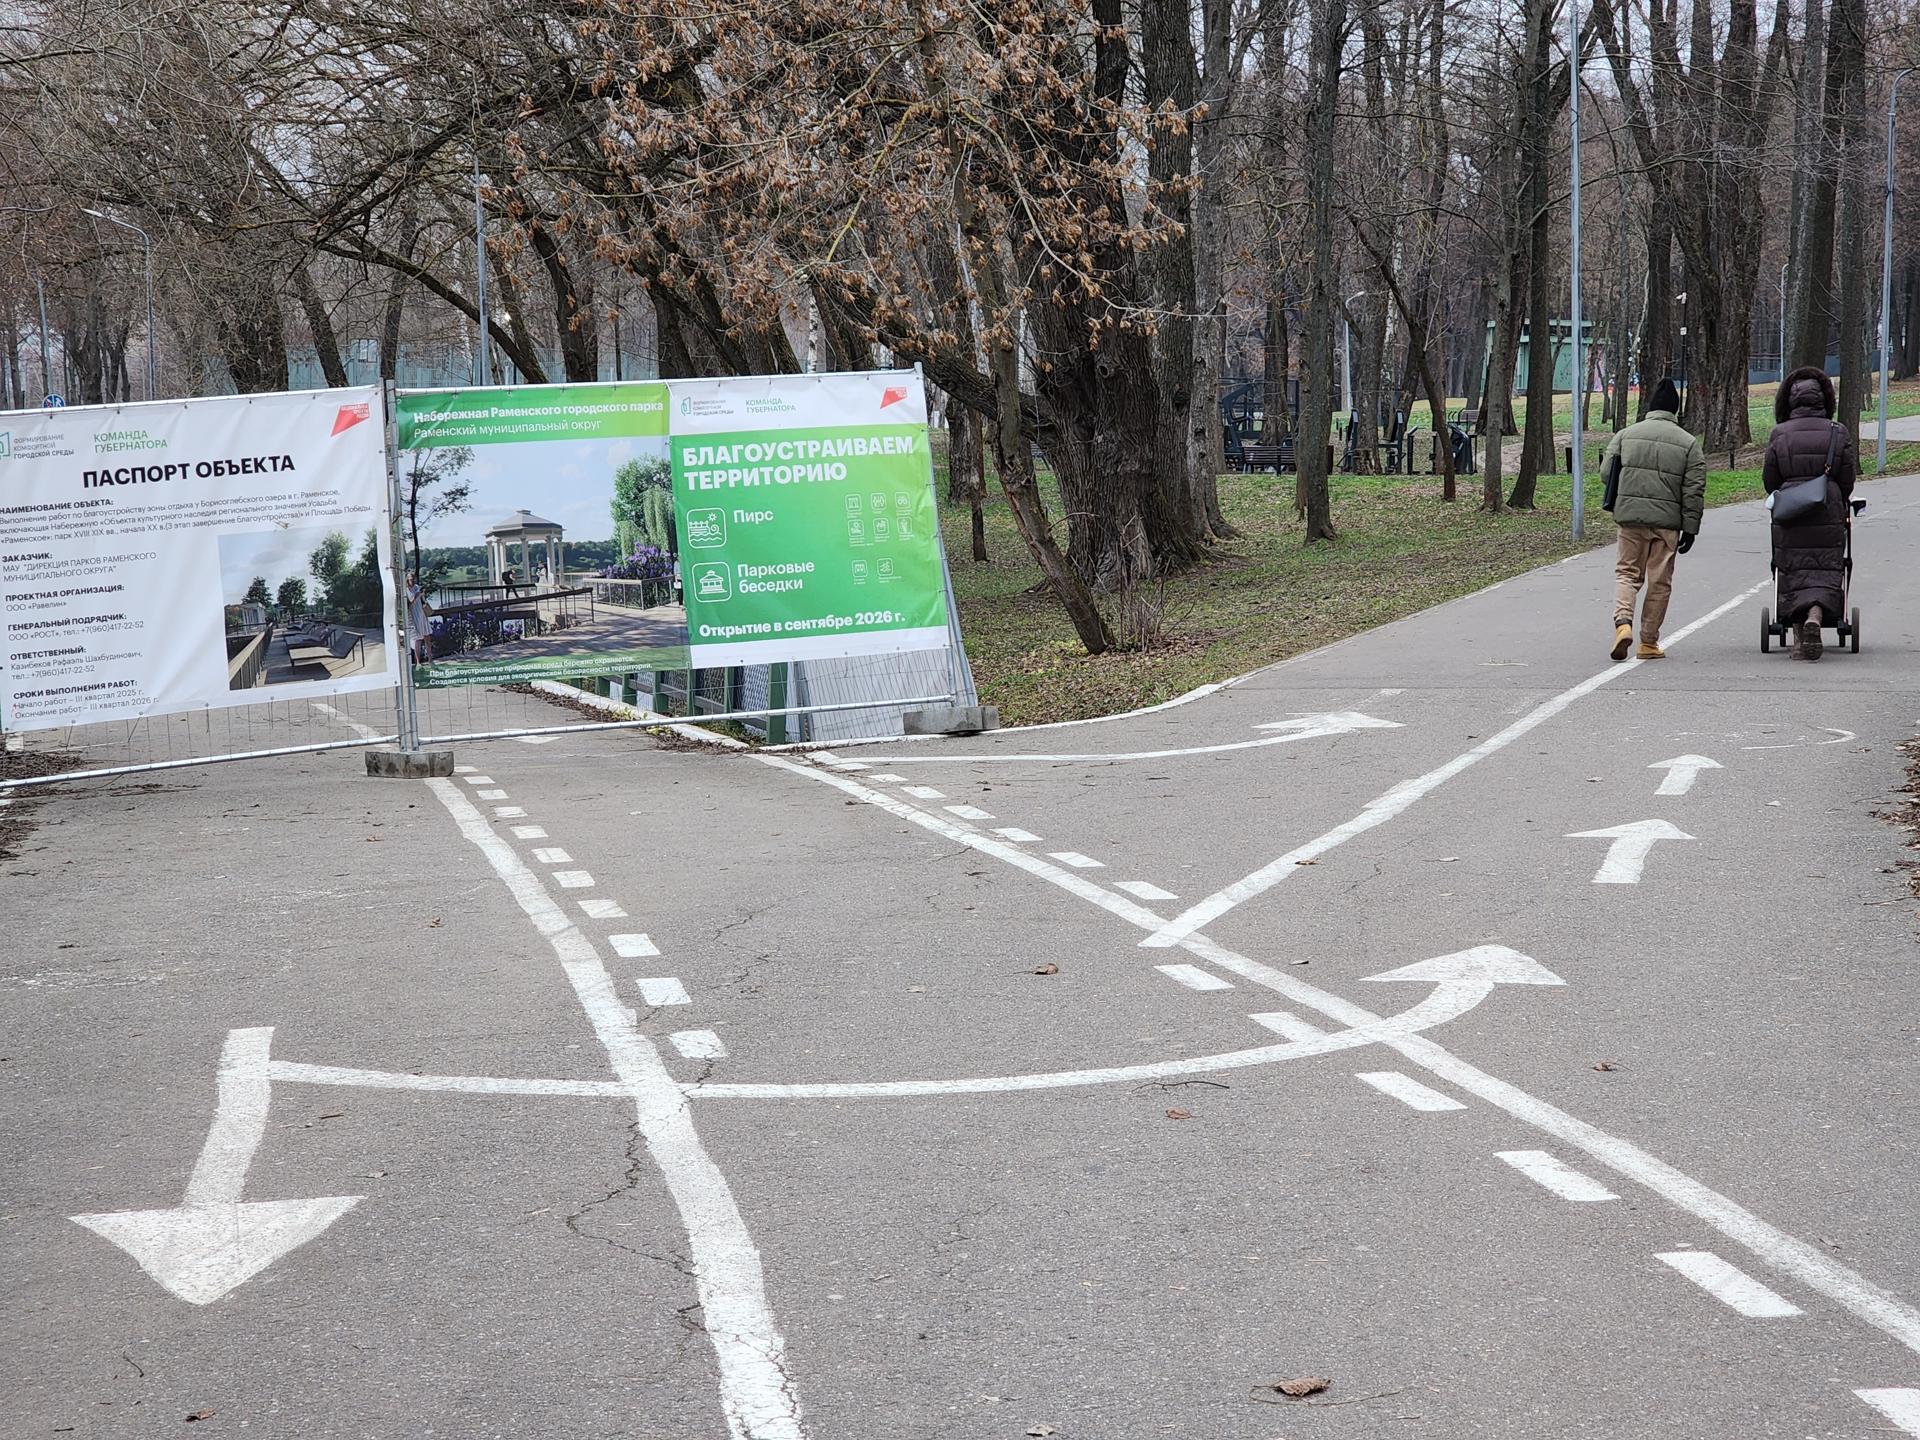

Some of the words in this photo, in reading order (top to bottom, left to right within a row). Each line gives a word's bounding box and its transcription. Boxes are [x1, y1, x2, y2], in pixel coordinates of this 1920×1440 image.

[745, 398, 783, 406] КОМАНДА
[746, 404, 796, 413] ГУБЕРНАТОРА
[414, 409, 489, 423] Набережная
[491, 406, 560, 418] Раменского
[563, 404, 628, 416] городского
[630, 402, 663, 413] парка
[93, 430, 148, 442] КОМАНДА
[414, 424, 476, 438] Раменский
[479, 420, 568, 436] муниципальный
[571, 420, 601, 430] округ
[13, 433, 64, 444] ФОРМИРОВАНИЕ
[13, 441, 56, 451] КОМФОРТНОЙ
[95, 439, 168, 453] ГУБЕРНАТОРА
[14, 450, 50, 459] ГОРОДСКОЙ
[682, 436, 914, 467] БЛАГОУСТРАИВАЕМ
[82, 463, 190, 488] ПАСПОРТ
[195, 455, 295, 478] ОБЪЕКТА
[684, 462, 847, 490] ТЕРРИТОРИЮ
[0, 503, 72, 514] НАИМЕНОВАНИЕ
[73, 499, 114, 508] ОБЪЕКТА:
[0, 515, 47, 525] Выполнение
[49, 512, 71, 522] работ
[83, 506, 145, 518] благоустройству
[201, 496, 263, 508] Борисоглебского
[265, 494, 286, 502] озера
[300, 489, 340, 499] Раменское,
[0, 525, 48, 535] включающая
[50, 520, 98, 531] Набережную
[100, 517, 136, 526] «Объекта
[137, 513, 182, 524] культурного
[184, 510, 217, 518] наследия
[218, 505, 273, 516] регионального
[274, 502, 307, 511] значения
[308, 499, 337, 508] Усадьба
[54, 533, 72, 541] парк
[120, 525, 145, 533] начала
[174, 521, 190, 529] этап
[192, 518, 235, 527] завершение
[311, 508, 342, 517] Площадь
[344, 505, 373, 513] Победы.
[733, 509, 774, 526] Пирс
[2, 553, 53, 563] ЗАКАЗЧИК:
[3, 564, 20, 573] МАУ
[23, 561, 69, 572] "ДИРЕКЦИЯ
[70, 557, 101, 567] ПАРКОВ
[103, 552, 157, 564] РАМЕНСКОГО
[3, 569, 82, 582] МУНИЦИПАЛЬНОГО
[83, 565, 117, 575] ОКРУГА"
[737, 561, 815, 579] Парковые
[5, 591, 58, 602] ПРОЕКТНАЯ
[59, 584, 125, 597] ОРГАНИЗАЦИЯ:
[739, 579, 803, 594] беседки
[27, 601, 67, 610] «Равелин»
[8, 618, 70, 632] ГЕНЕРАЛЬНЫЙ
[71, 613, 127, 625] ПОДРЯДЧИК:
[8, 633, 29, 641] ООО
[81, 621, 144, 634] +7(960)417-22-52
[699, 623, 771, 638] Открытие
[774, 623, 782, 631] в
[784, 614, 853, 632] сентябре
[855, 610, 892, 625] 2026
[895, 613, 906, 622] г.
[10, 645, 87, 660] ОТВЕТСТВЕННЫЙ:
[10, 660, 51, 670] Казибеков
[52, 657, 84, 667] Рафаэль
[85, 651, 143, 664] Шахбудинович,
[31, 665, 95, 678] +7(960)417-22-52
[429, 670, 444, 679] При
[444, 665, 503, 679] благоустройстве
[504, 663, 541, 673] природная
[542, 662, 562, 671] среда
[563, 659, 593, 669] бережно
[429, 678, 468, 686] Создаются
[469, 675, 496, 684] условия
[497, 674, 511, 682] для
[511, 670, 562, 680] экологической
[563, 666, 610, 676] безопасности
[611, 663, 653, 674] территории.
[13, 690, 44, 700] СРОКИ
[45, 682, 106, 696] ВЫПОЛНЕНИЯ
[107, 679, 138, 688] РАБОТ:
[44, 697, 67, 707] работ
[84, 692, 116, 701] квартал
[116, 689, 137, 697] 2025
[15, 709, 57, 719] Окончание
[59, 705, 82, 715] работ
[99, 701, 130, 710] квартал
[130, 697, 152, 706] 2026
